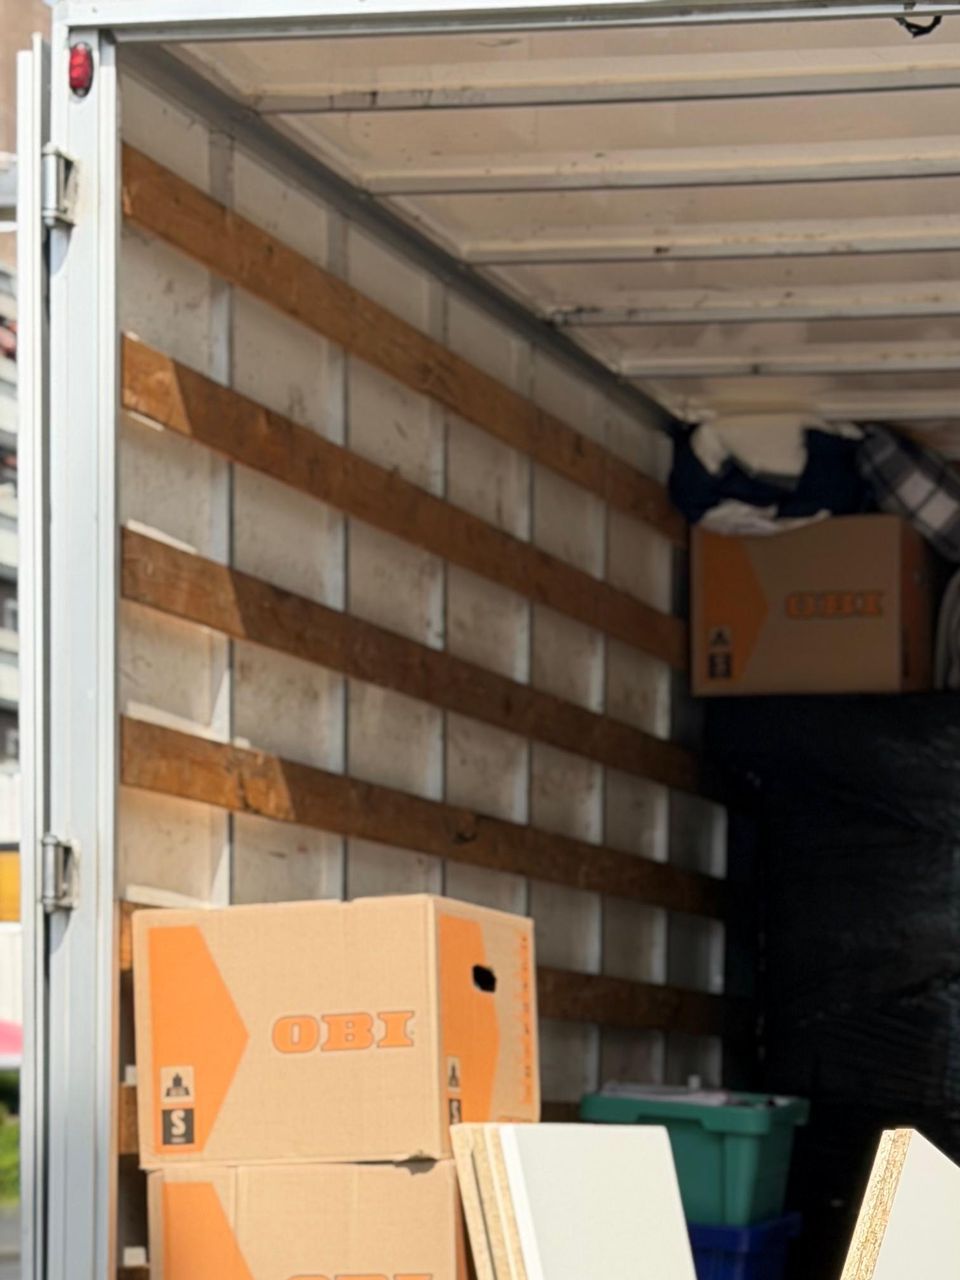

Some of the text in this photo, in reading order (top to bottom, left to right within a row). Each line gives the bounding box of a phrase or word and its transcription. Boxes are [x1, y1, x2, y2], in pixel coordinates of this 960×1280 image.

[785, 590, 884, 619] OBI
[272, 1010, 415, 1054] OBI
[170, 1108, 186, 1136] S
